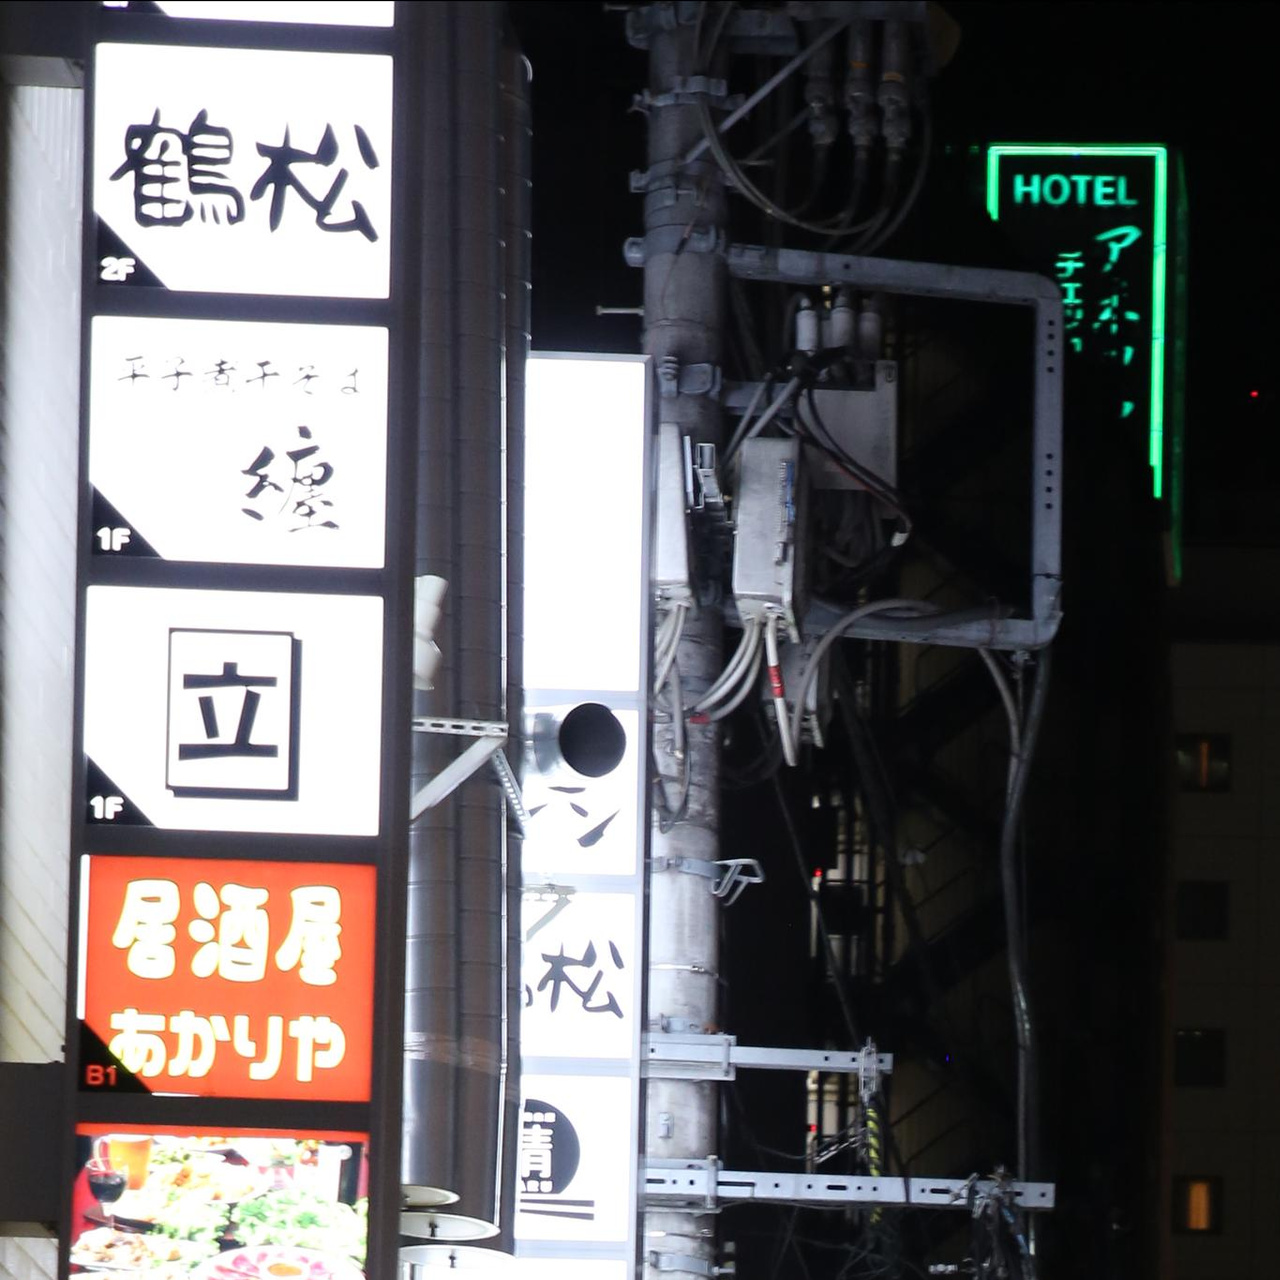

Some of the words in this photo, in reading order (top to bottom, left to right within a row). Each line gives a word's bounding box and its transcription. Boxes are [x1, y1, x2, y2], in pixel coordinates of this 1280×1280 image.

[110, 106, 380, 243] 鶴松
[1013, 174, 1138, 206] HOTEL
[100, 257, 136, 282] 2F
[97, 526, 131, 551] 1F
[178, 661, 279, 761] 立
[90, 795, 124, 820] 1F
[111, 878, 342, 988] 居酒屋
[109, 1008, 347, 1082] あかりや
[86, 1064, 118, 1086] B1
